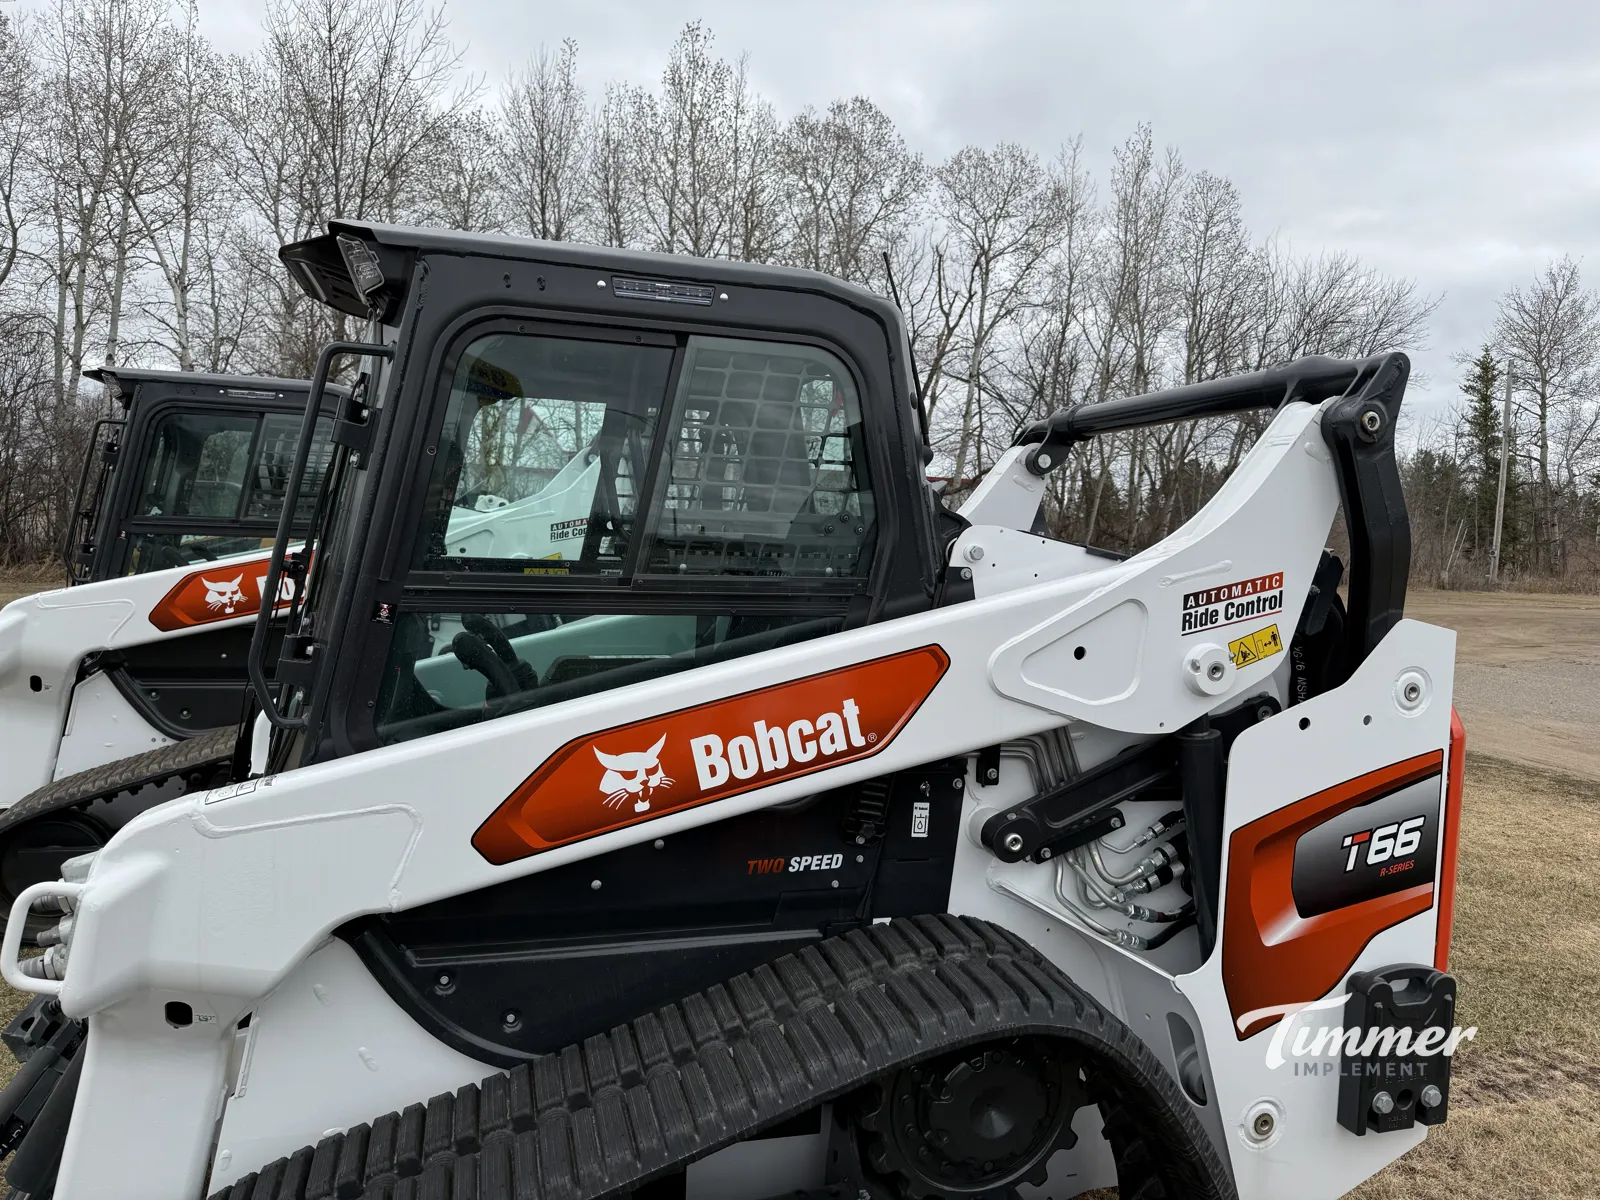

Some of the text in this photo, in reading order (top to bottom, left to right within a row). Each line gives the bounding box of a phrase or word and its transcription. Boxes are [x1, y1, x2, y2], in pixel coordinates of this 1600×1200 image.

[550, 529, 570, 541] Ride
[552, 518, 588, 531] AUTOMA
[1187, 576, 1280, 608] AUTOMATIC
[1181, 590, 1283, 632] Ride Control
[690, 698, 866, 790] Bobcat
[1342, 815, 1425, 872] T66
[747, 853, 843, 875] TWO SPEED
[1380, 860, 1415, 877] R-SERIES
